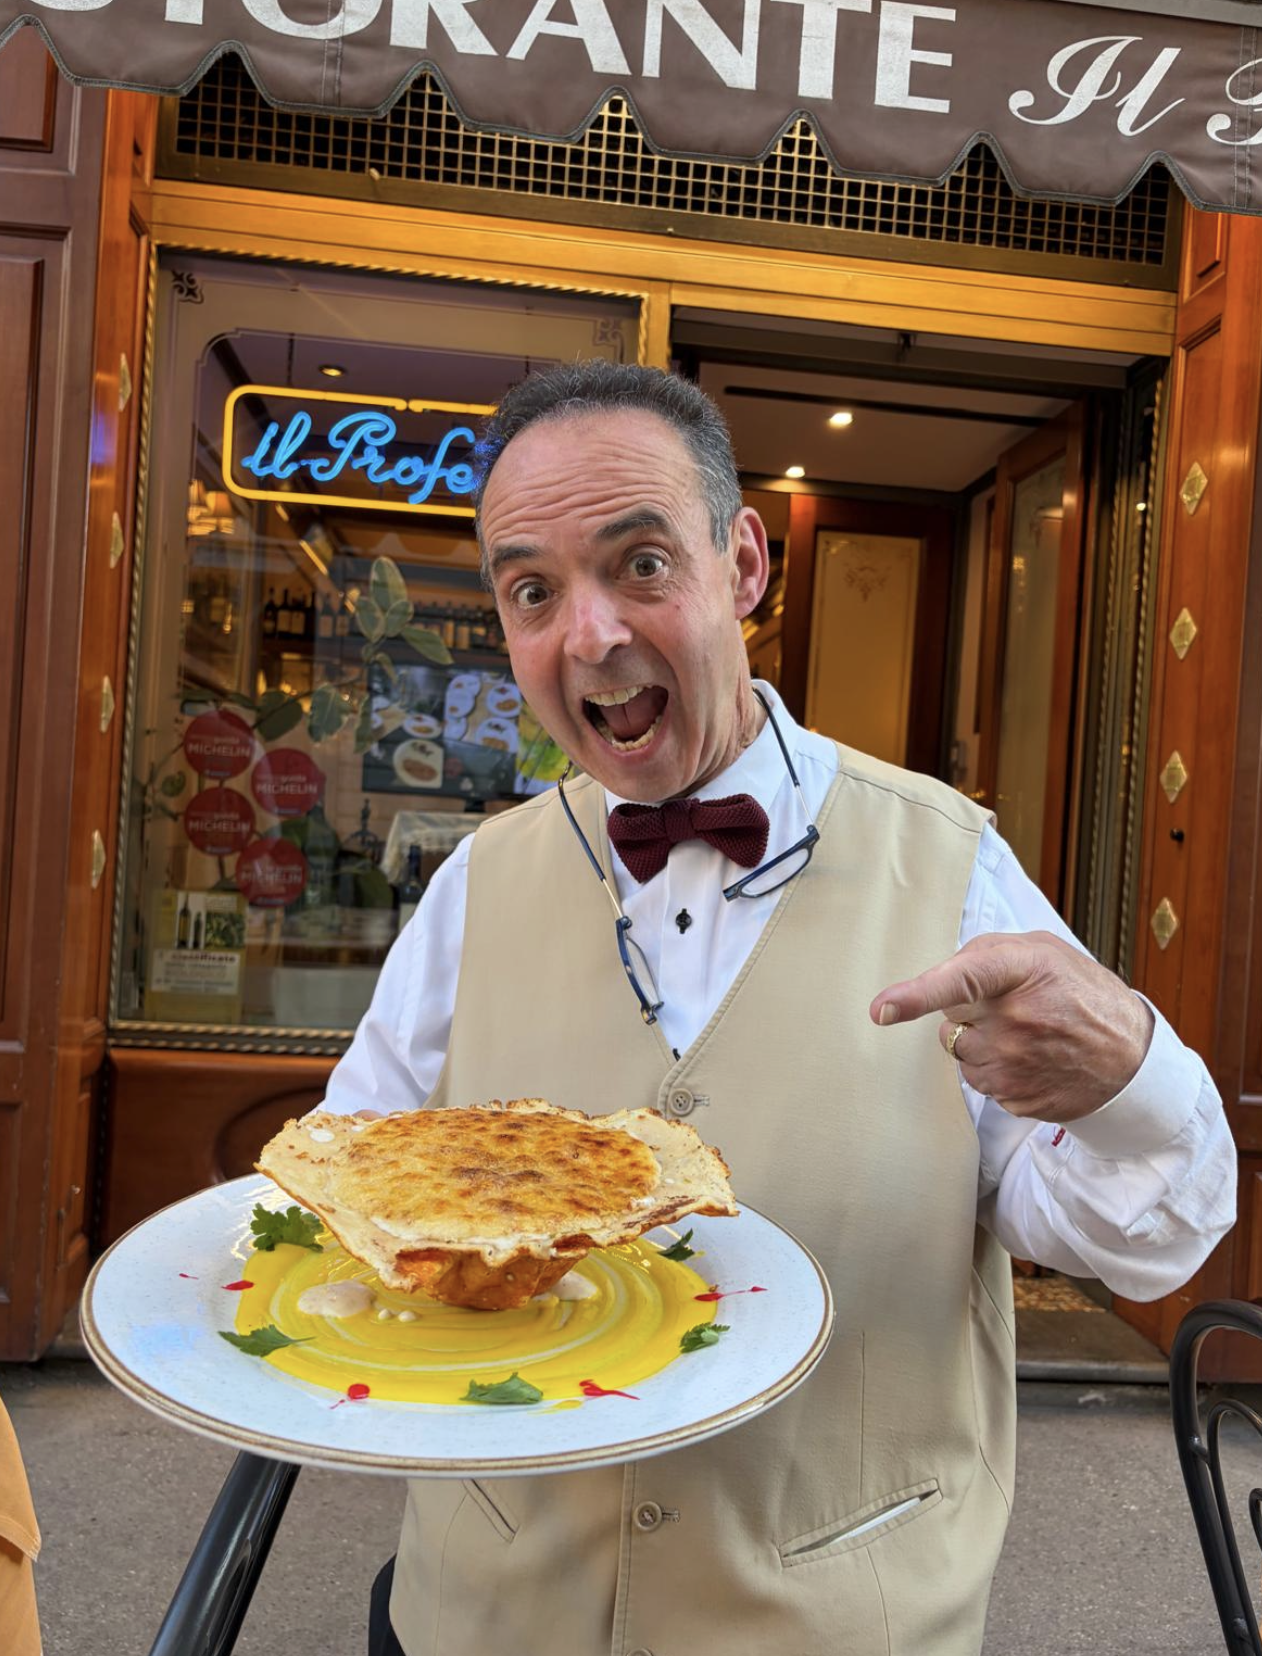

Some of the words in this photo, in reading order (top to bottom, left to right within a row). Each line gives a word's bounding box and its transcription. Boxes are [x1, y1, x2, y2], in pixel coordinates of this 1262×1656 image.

[28, 0, 956, 114] ANTE
[1008, 35, 1187, 137] Il
[241, 411, 312, 479] Il
[310, 411, 478, 505] Profe
[188, 742, 250, 757] MICHELIN
[256, 783, 318, 795] MICHELIN
[188, 820, 250, 833] MICHELIN
